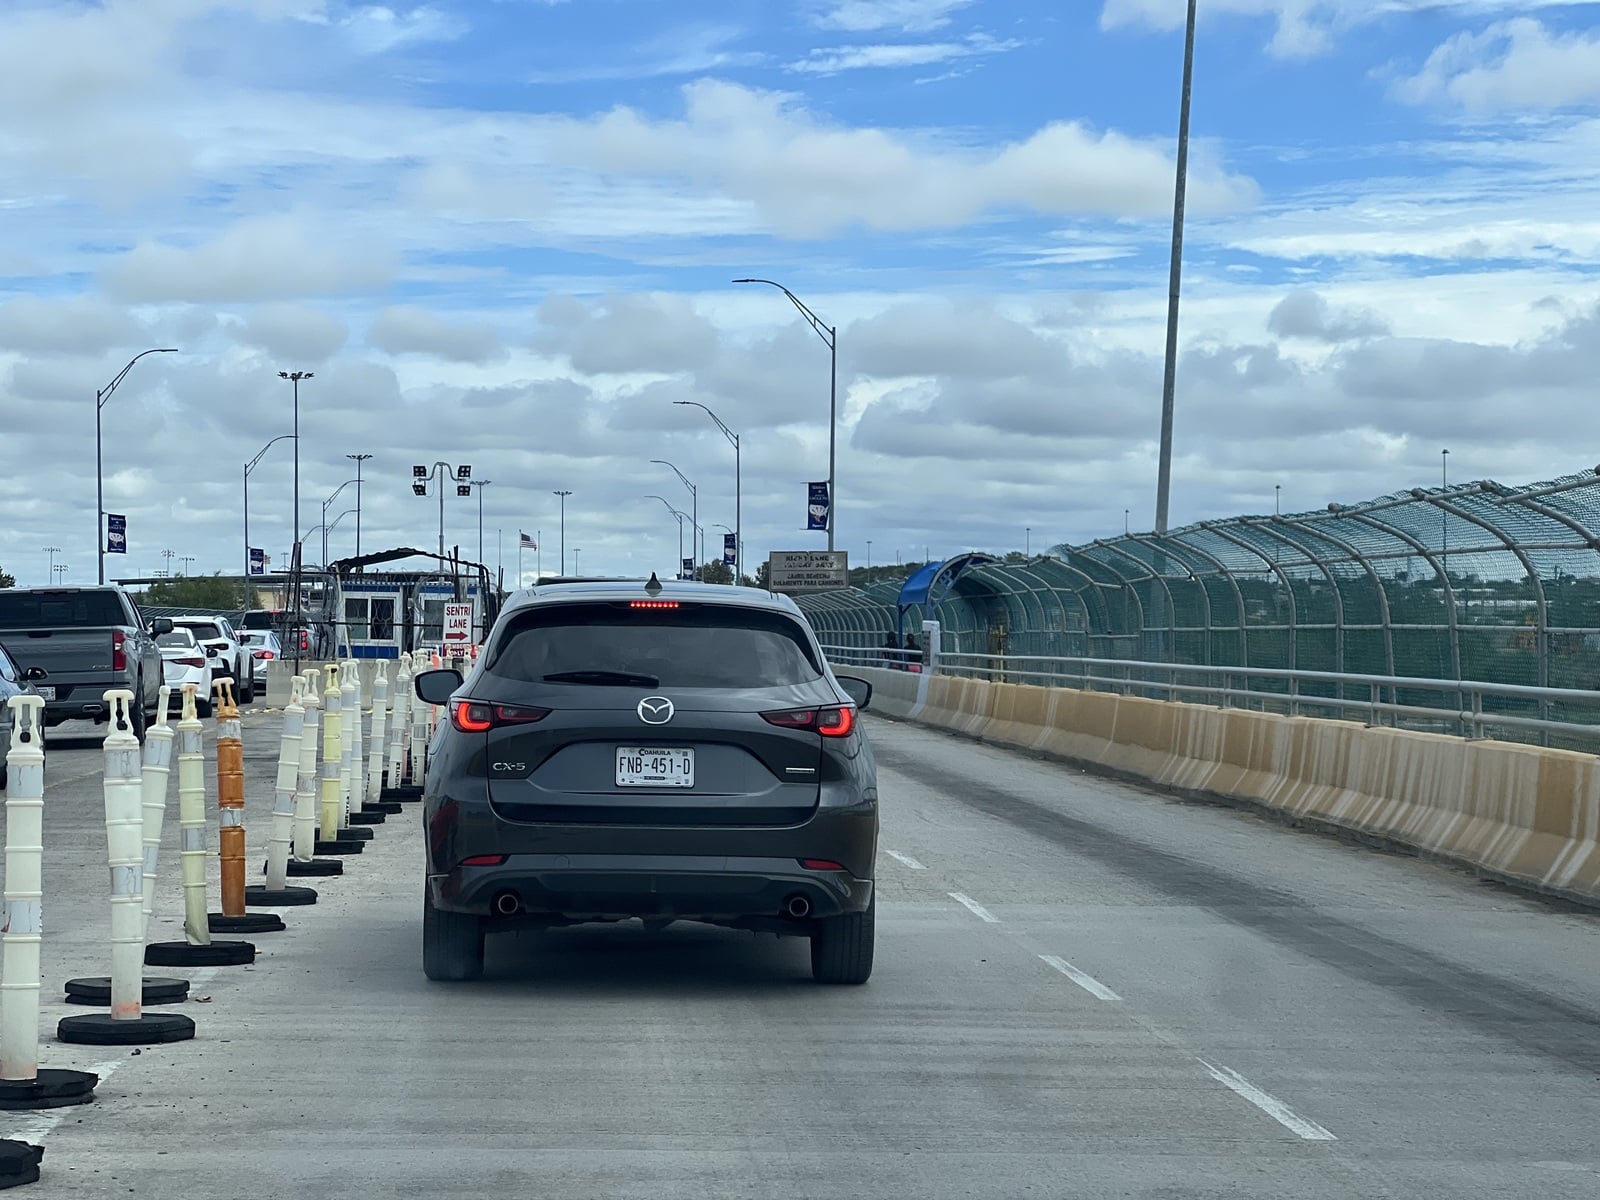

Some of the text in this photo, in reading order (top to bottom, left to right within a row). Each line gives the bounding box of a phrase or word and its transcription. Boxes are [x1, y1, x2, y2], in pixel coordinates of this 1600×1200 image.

[446, 606, 470, 616] SENTRI
[449, 619, 467, 629] LANE
[638, 748, 671, 756] COAHUILA
[492, 762, 526, 770] CX-5
[619, 757, 690, 775] FNB-451-D
